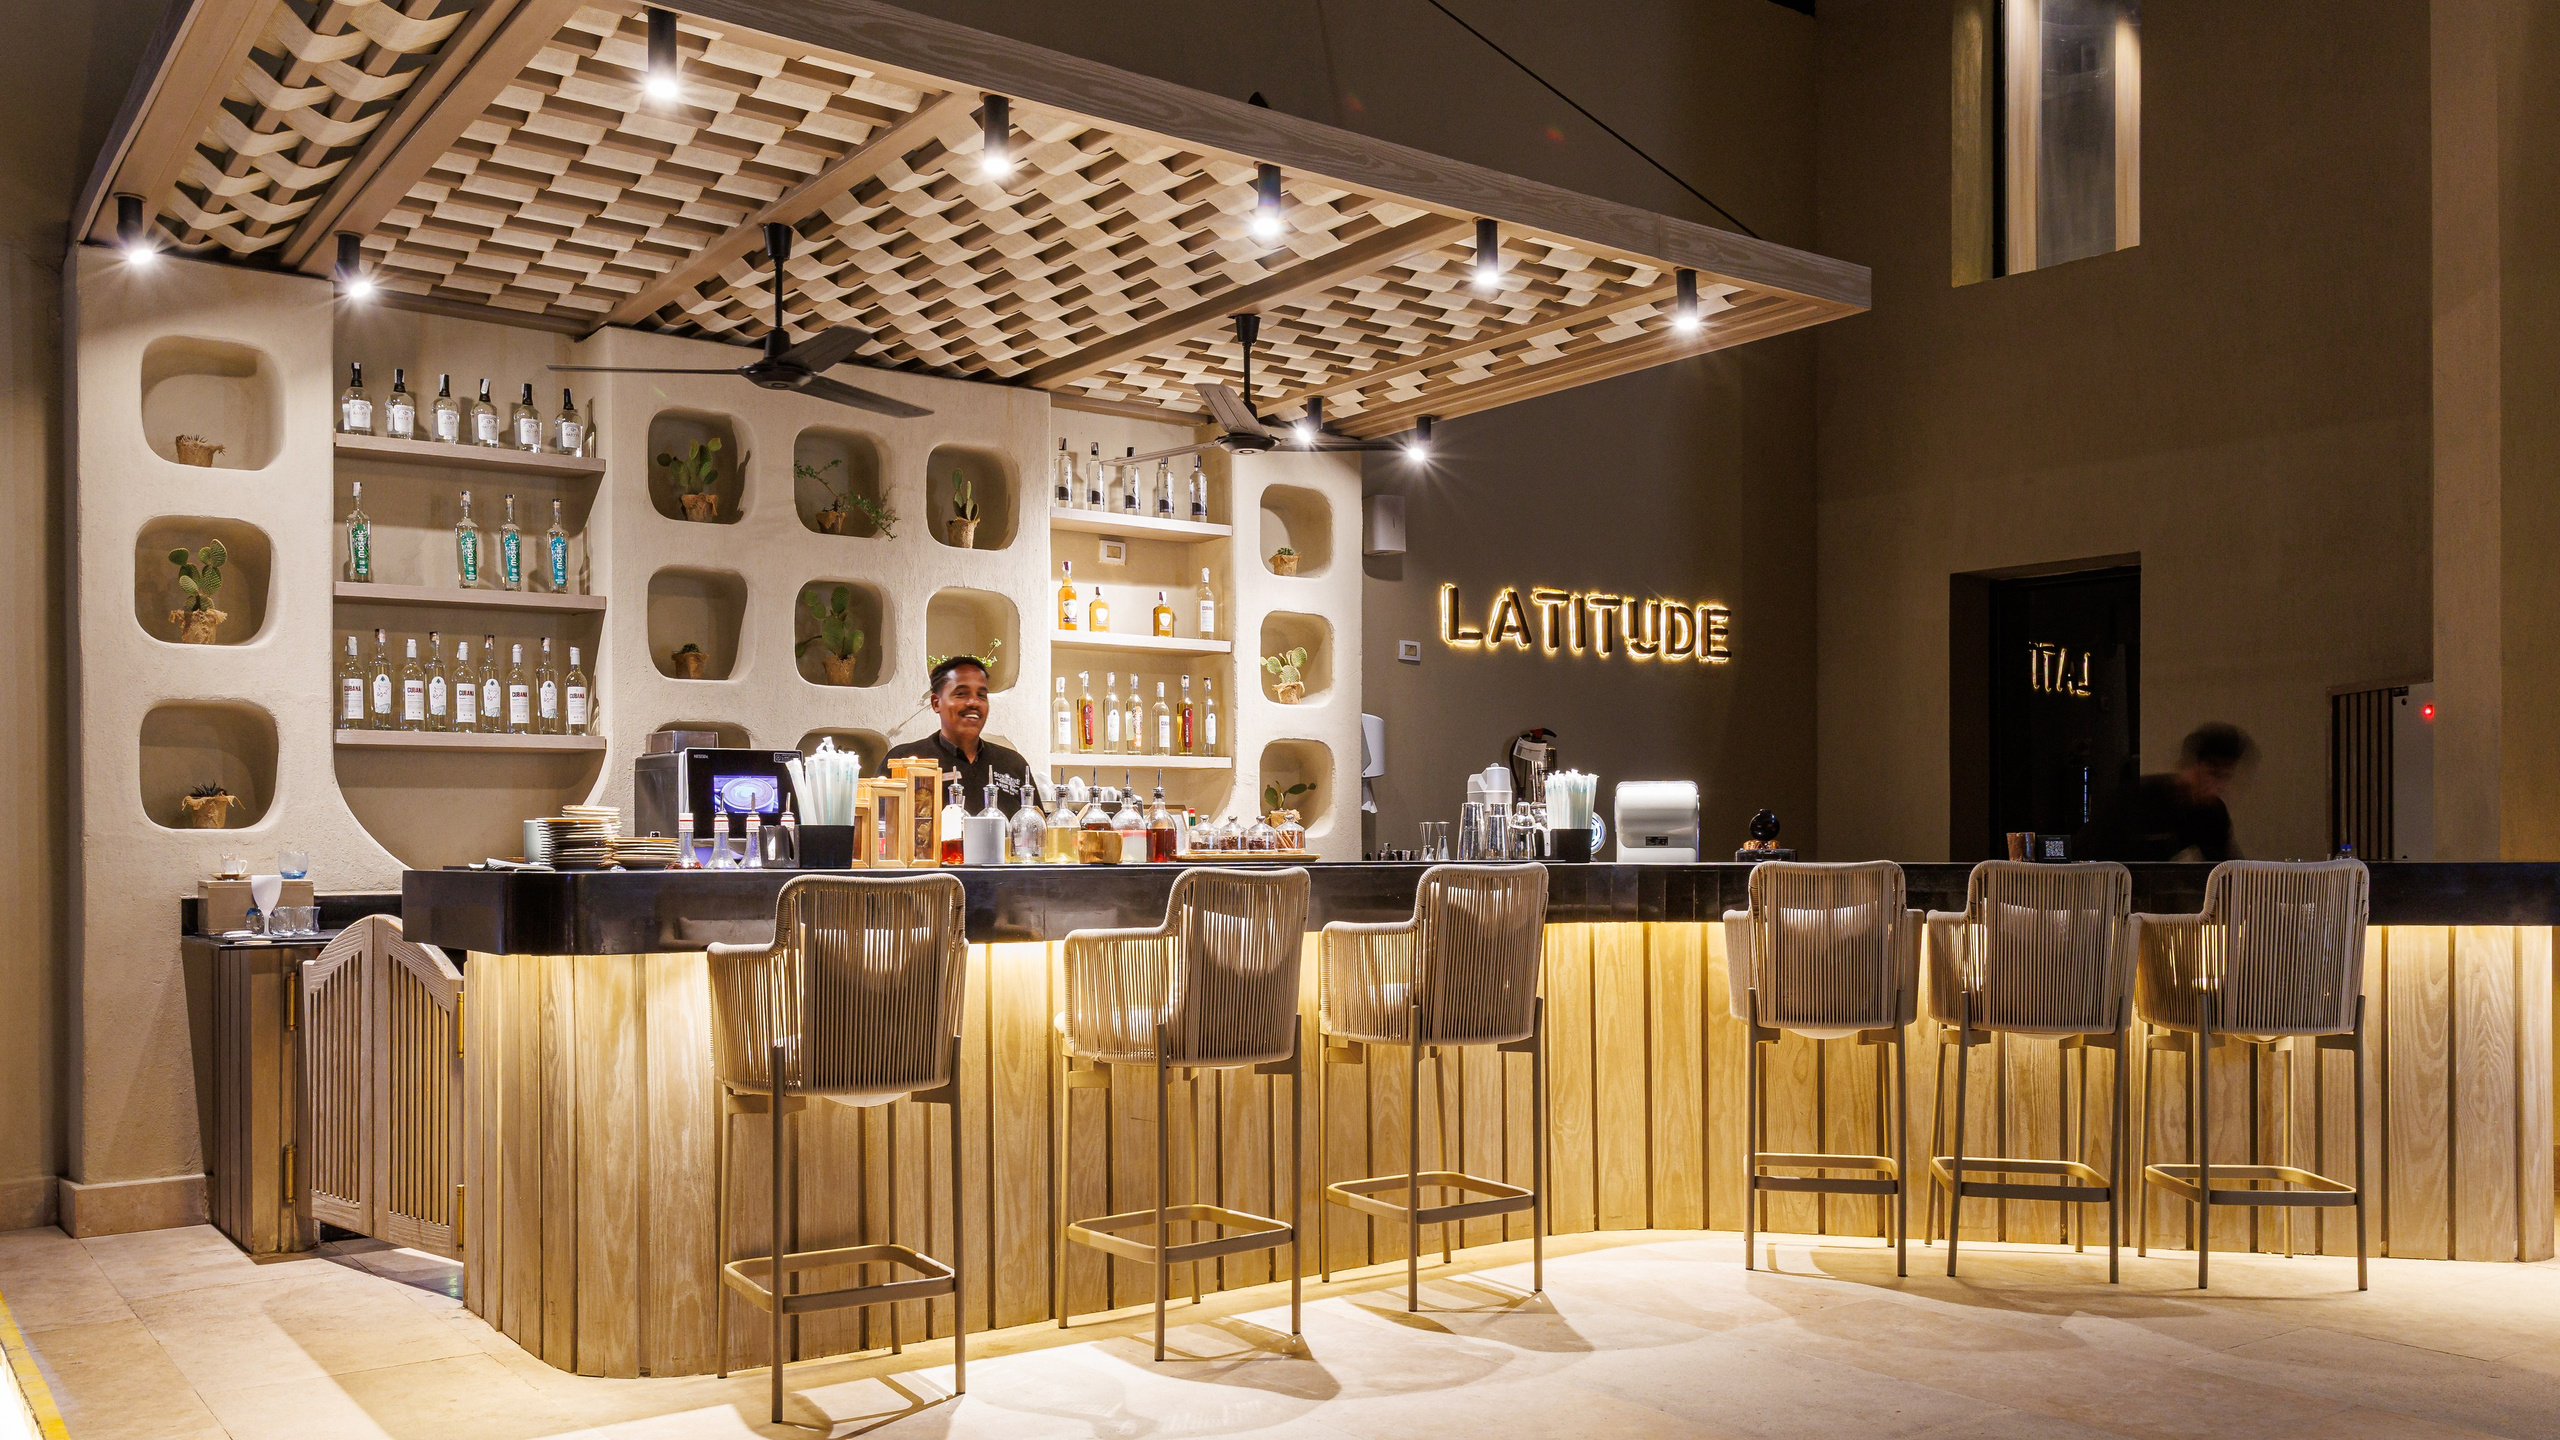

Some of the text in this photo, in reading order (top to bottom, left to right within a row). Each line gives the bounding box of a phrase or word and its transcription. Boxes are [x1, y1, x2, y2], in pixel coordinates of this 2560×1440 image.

[356, 530, 365, 558] mosaic
[467, 537, 475, 565] mosaic
[509, 539, 517, 566] mosaic
[555, 542, 563, 570] mosaic
[1441, 583, 1732, 663] LATITUDE
